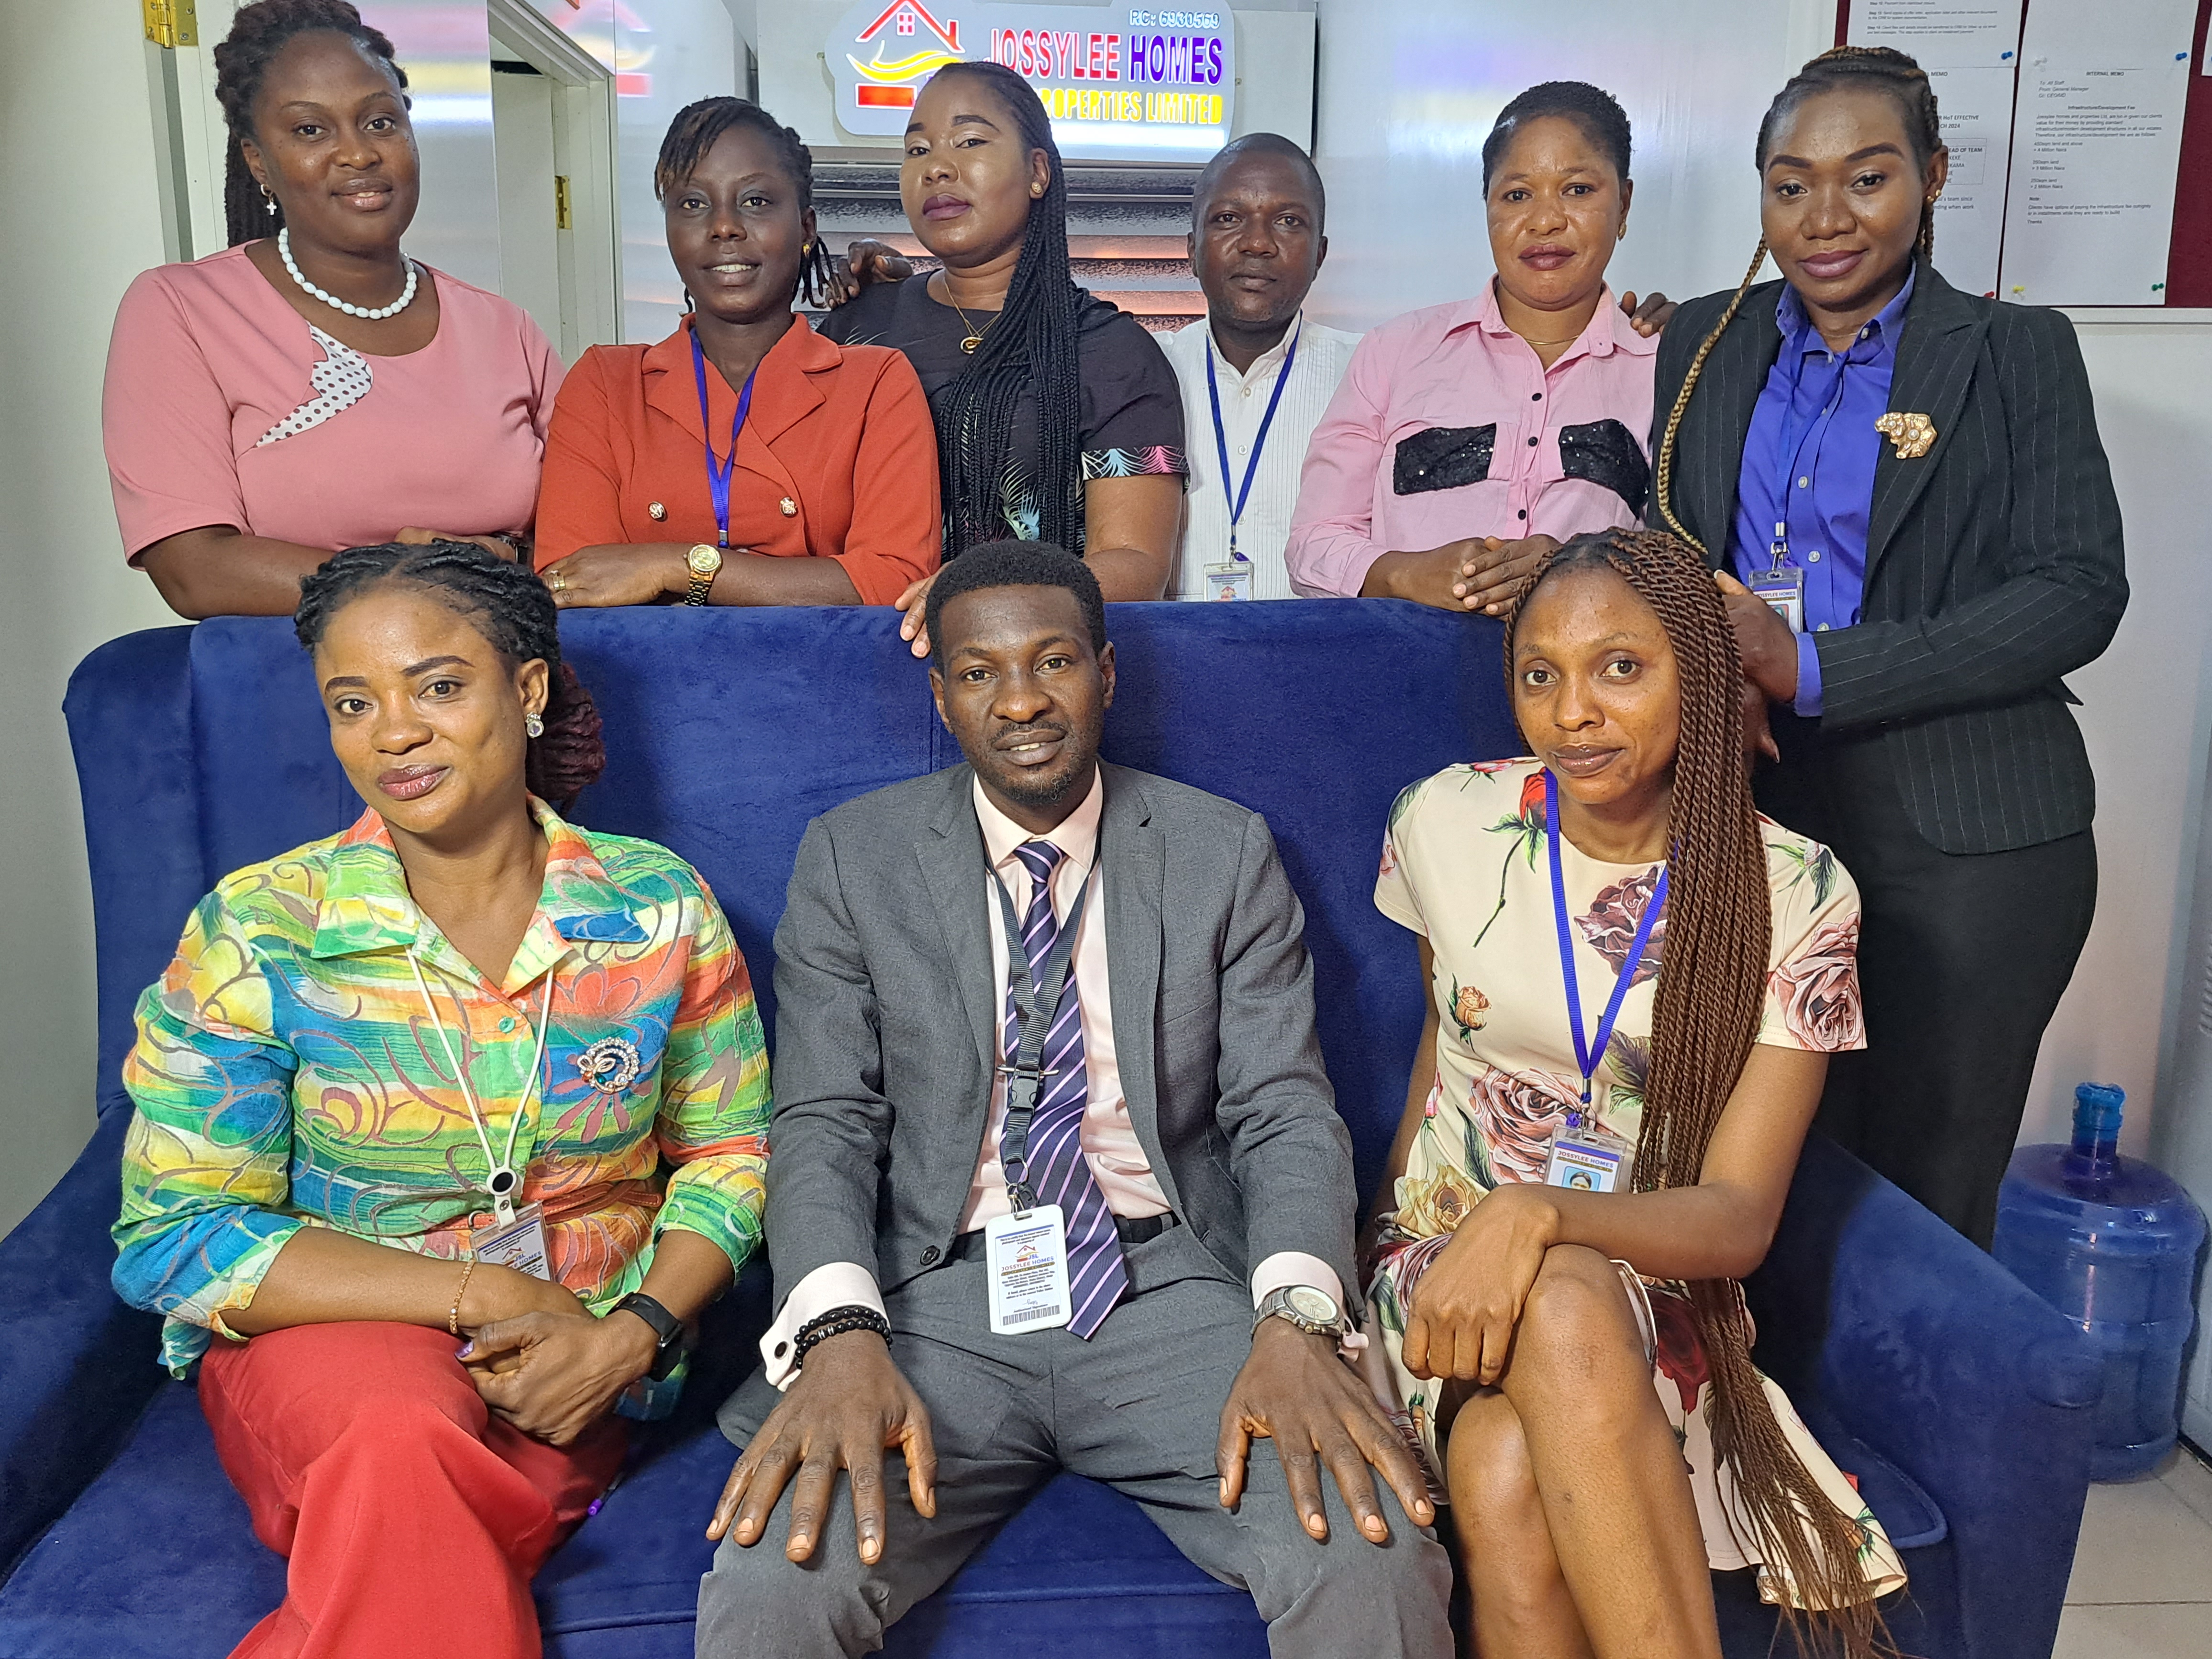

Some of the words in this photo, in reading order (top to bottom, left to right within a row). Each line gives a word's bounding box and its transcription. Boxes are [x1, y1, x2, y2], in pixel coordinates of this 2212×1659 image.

[1129, 9, 1156, 26] RC:
[1159, 10, 1220, 29] 6930569
[983, 28, 1121, 81] JOSSYLEE
[1128, 34, 1223, 86] HOMES
[1033, 88, 1142, 122] ROPERTIES
[1145, 92, 1223, 124] LIMITED
[1558, 1150, 1589, 1162] JOSSYLEE
[1590, 1158, 1614, 1168] HOMES
[514, 1253, 526, 1262] JSL
[519, 1250, 542, 1265] HOMES
[1001, 1261, 1030, 1272] JOSSYLEE
[1032, 1256, 1054, 1265] HOMES
